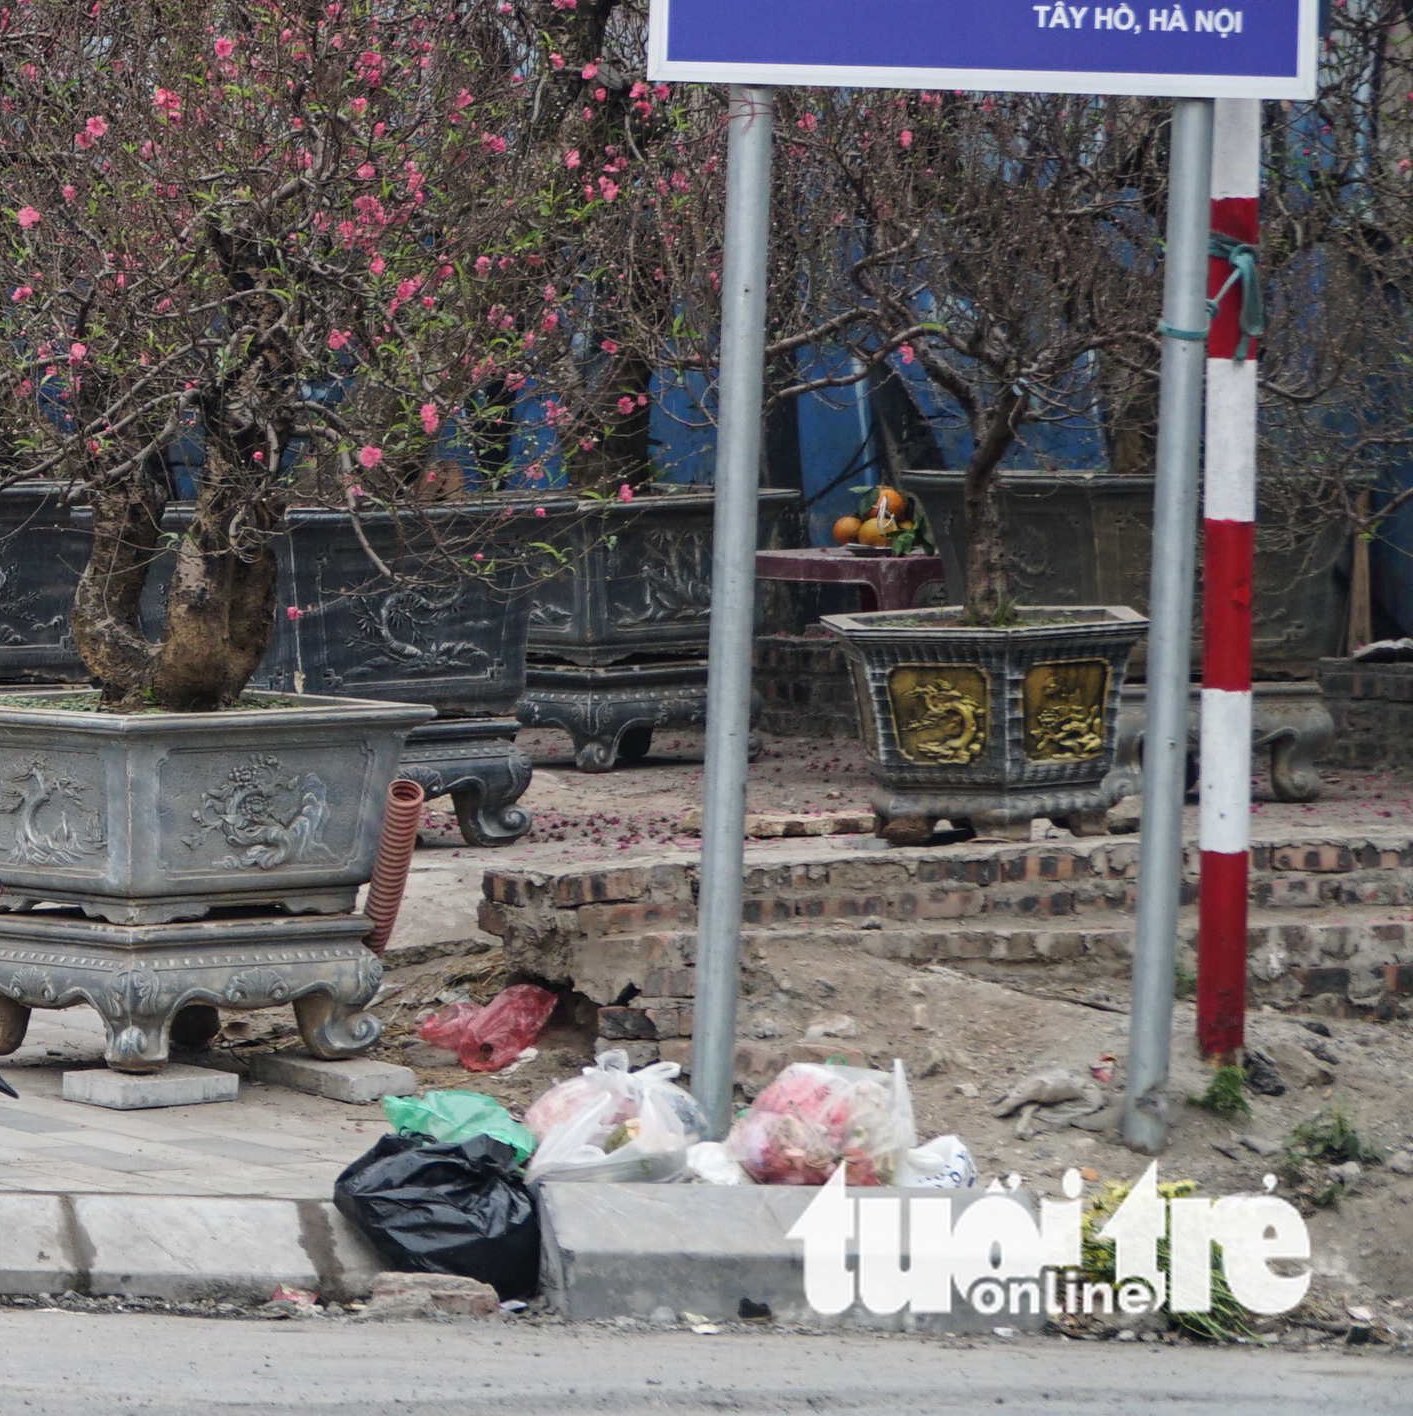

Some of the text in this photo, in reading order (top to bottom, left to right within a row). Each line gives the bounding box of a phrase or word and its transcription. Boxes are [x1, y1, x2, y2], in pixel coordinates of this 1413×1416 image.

[1032, 0, 1244, 39] TÂY HỒ, HÀ NỘI
